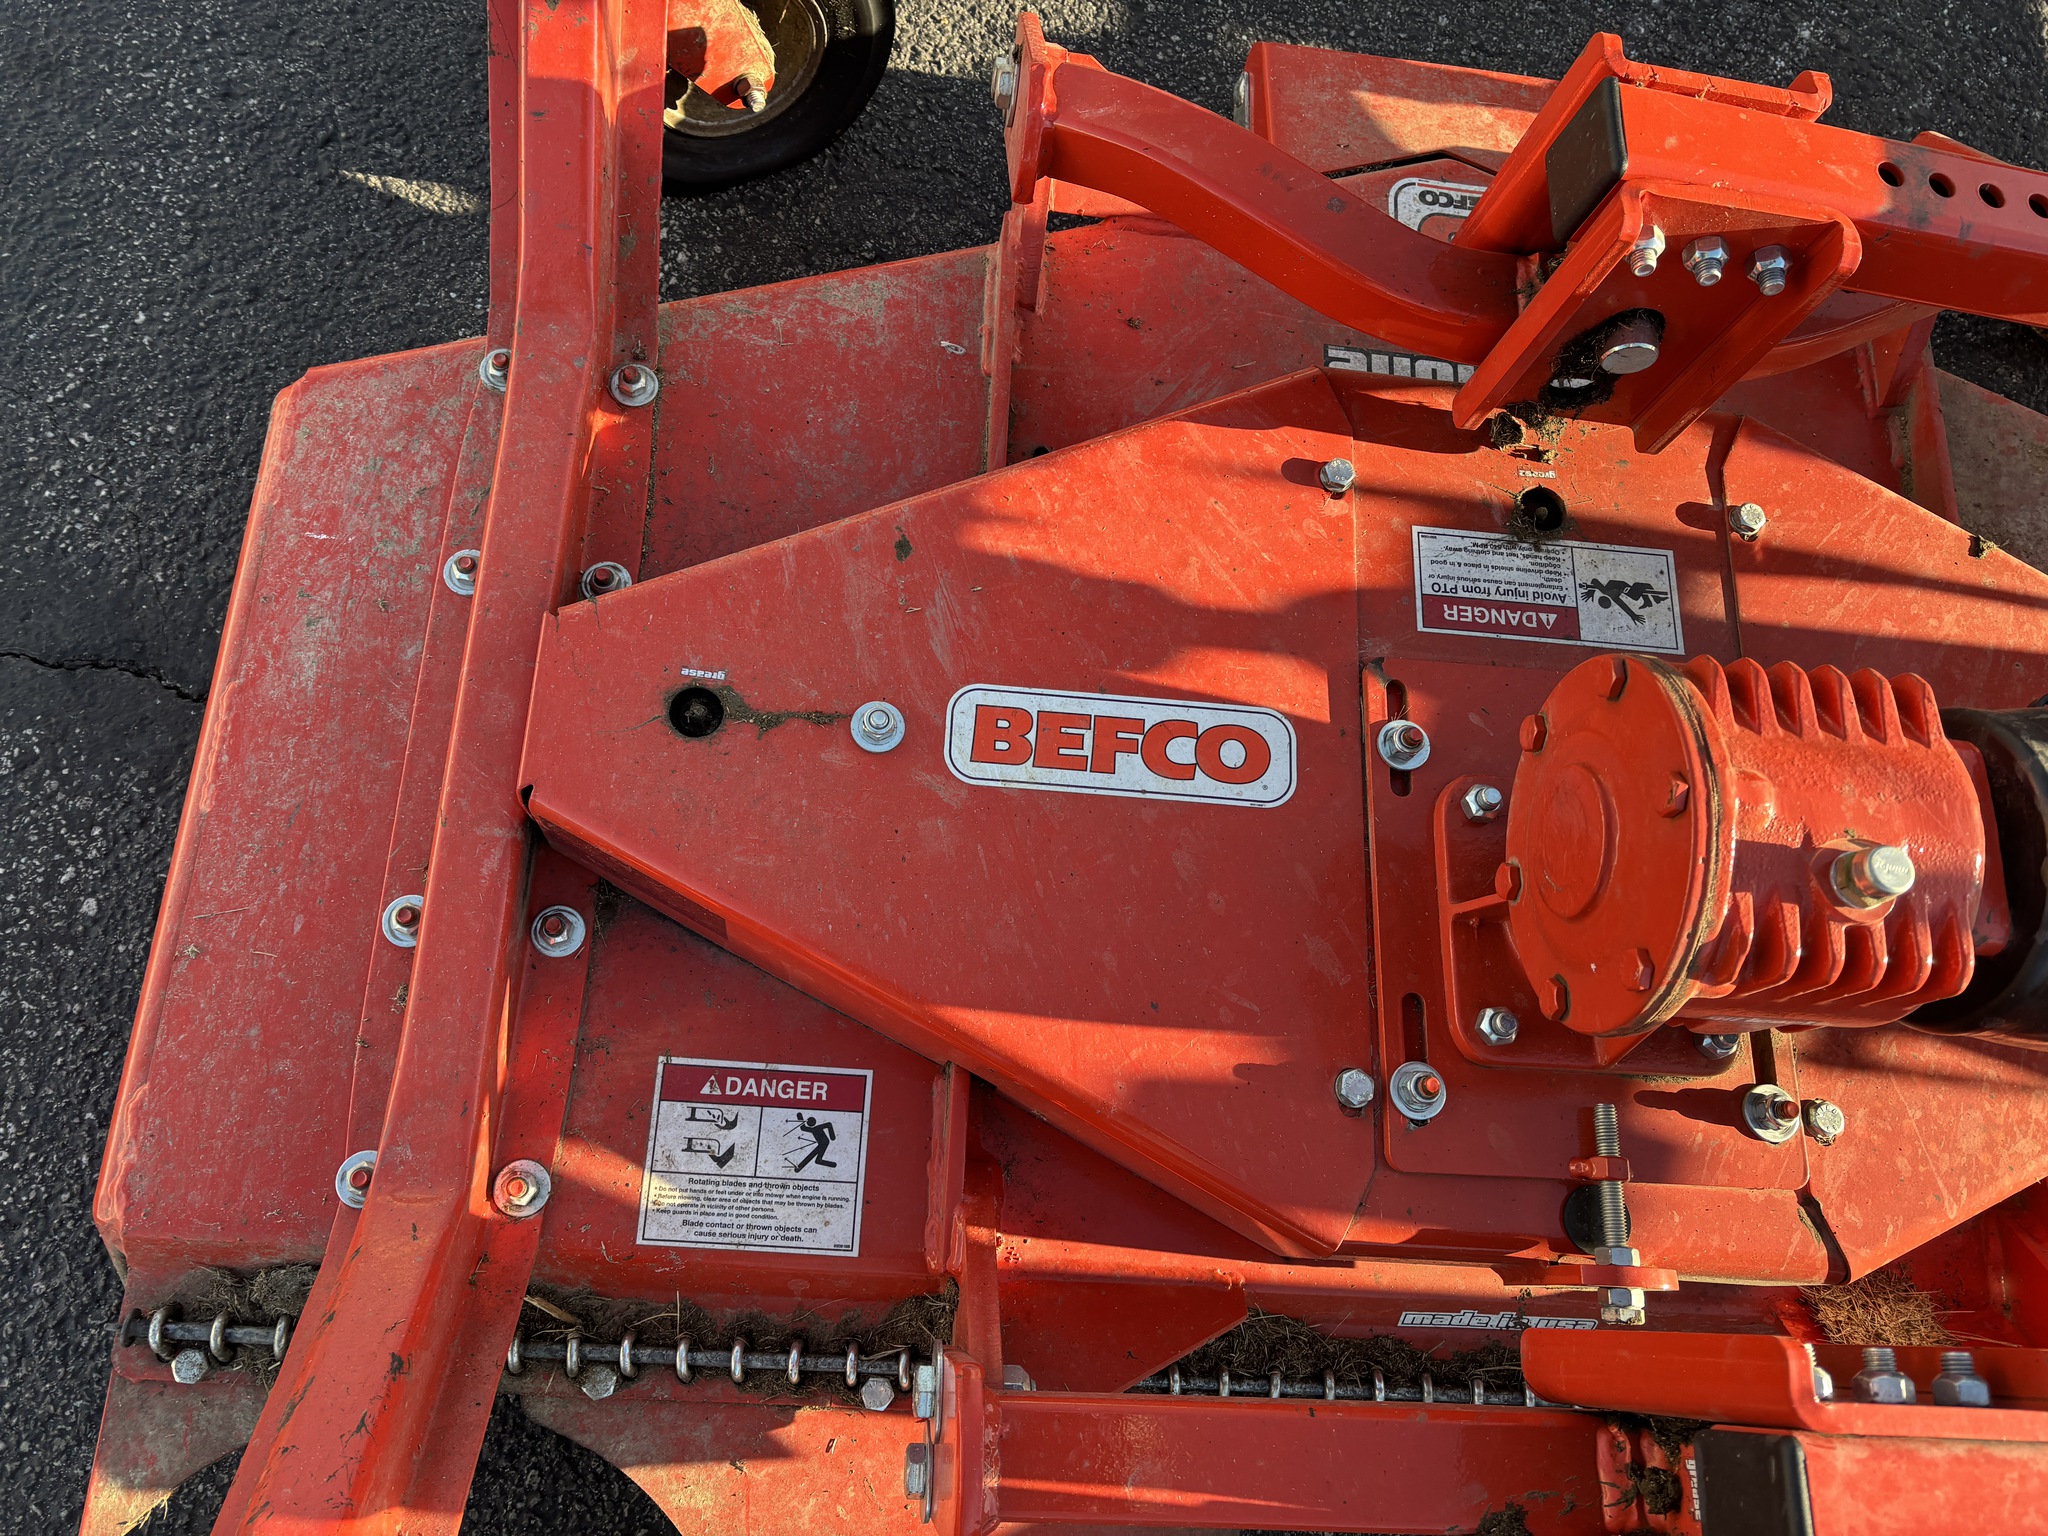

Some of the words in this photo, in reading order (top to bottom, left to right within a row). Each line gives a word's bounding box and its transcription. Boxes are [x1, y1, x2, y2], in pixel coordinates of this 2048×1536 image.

[1419, 190, 1480, 210] EFCO
[1443, 544, 1462, 552] away.
[1463, 546, 1490, 555] clothing
[1533, 546, 1559, 555] Opera
[1519, 552, 1542, 560] hands,
[1543, 554, 1560, 562] Keep
[1463, 561, 1481, 569] place
[1490, 564, 1513, 572] shields
[1528, 560, 1560, 569] condition.
[1515, 566, 1543, 575] driveline
[1543, 568, 1561, 576] Keep
[1455, 575, 1480, 583] serious
[1430, 581, 1457, 594] PTO
[1461, 583, 1491, 597] from
[1517, 580, 1563, 591] Entanglement
[1494, 585, 1528, 600] injury
[1532, 590, 1567, 604] Avoid
[1442, 602, 1537, 628] DANGER
[680, 667, 726, 680] grease
[970, 704, 1271, 784] BEFCO
[725, 1076, 828, 1101] DANGER
[687, 1177, 720, 1187] Rotating
[721, 1179, 746, 1187] blades
[748, 1180, 762, 1188] and
[763, 1181, 790, 1190] thrown
[792, 1183, 819, 1193] objects
[677, 1194, 702, 1202] mowing,
[671, 1208, 691, 1216] guards
[681, 1219, 704, 1227] Blade
[705, 1221, 734, 1229] contact
[745, 1222, 773, 1231] thrown
[773, 1224, 802, 1234] objects
[718, 1230, 746, 1239] serious
[747, 1232, 769, 1242] injury
[780, 1234, 803, 1242] death.
[1402, 1312, 1490, 1327] made
[1536, 1320, 1597, 1330] usa
